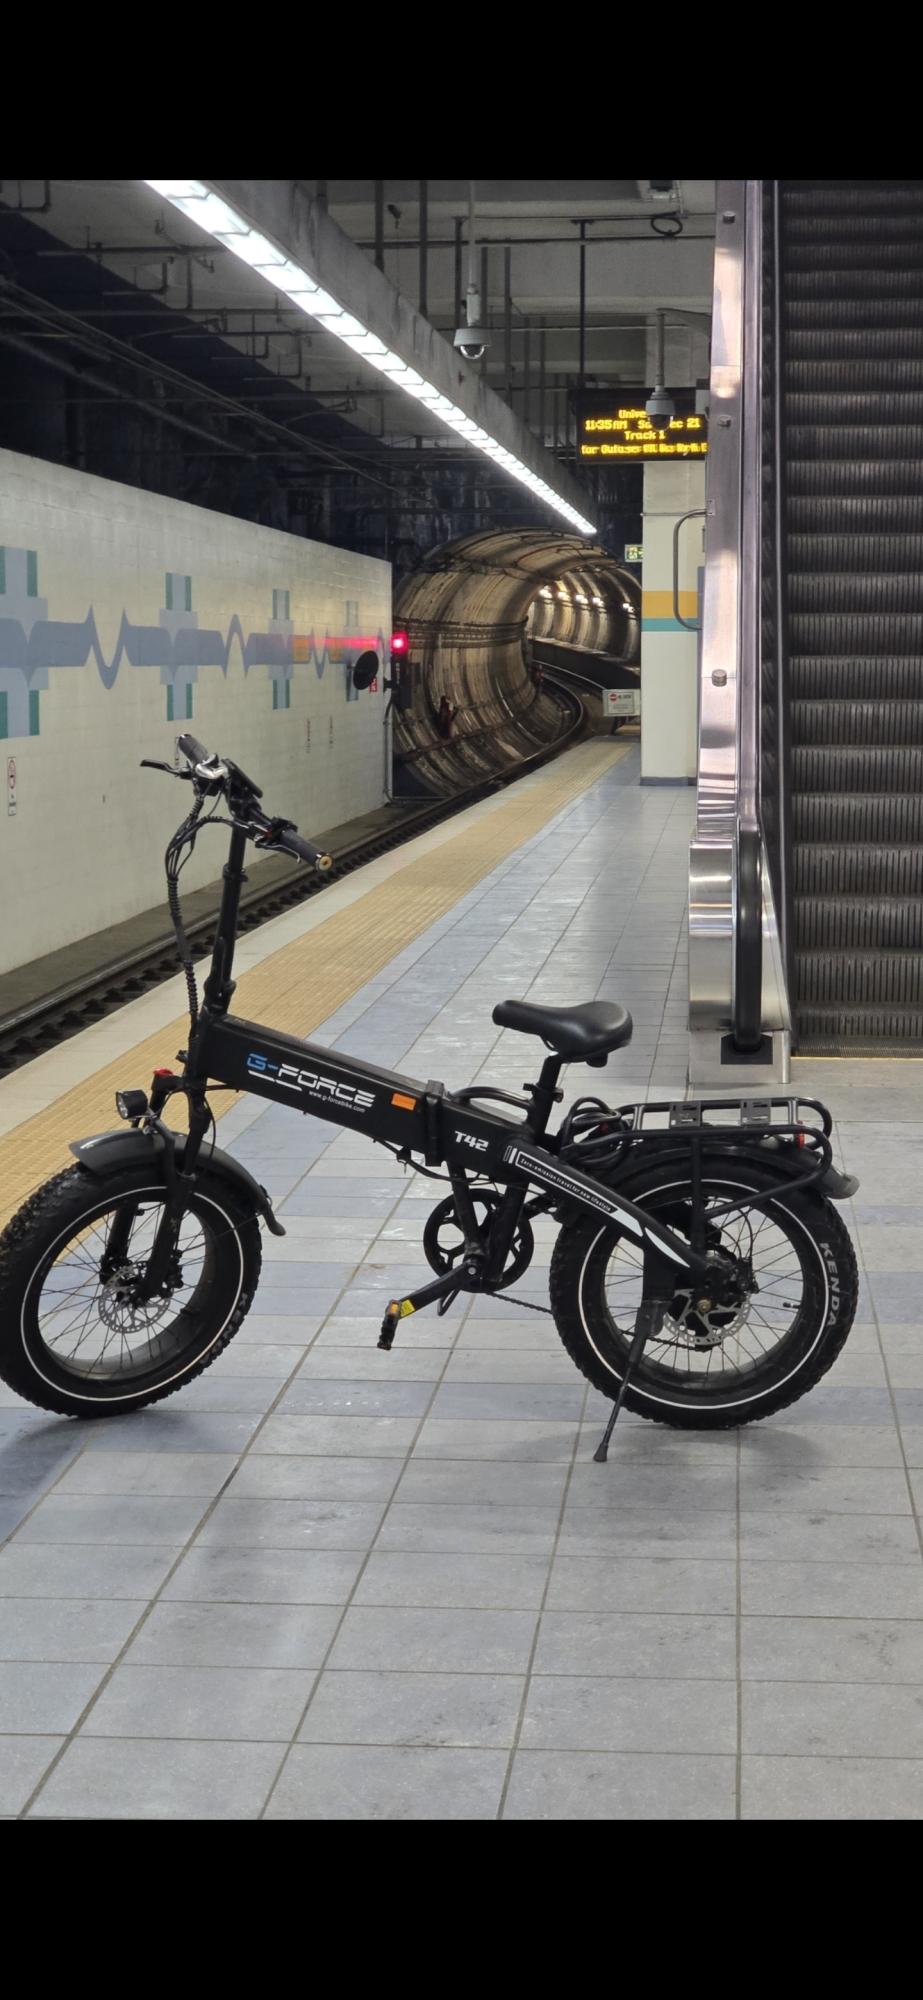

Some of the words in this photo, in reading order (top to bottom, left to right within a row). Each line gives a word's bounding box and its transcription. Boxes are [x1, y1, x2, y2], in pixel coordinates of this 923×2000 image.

[687, 418, 700, 428] 21
[624, 431, 656, 440] Track
[659, 430, 666, 440] 1
[246, 1053, 376, 1108] G-FORCE
[454, 1130, 490, 1152] T42
[820, 1243, 841, 1326] KENDA
